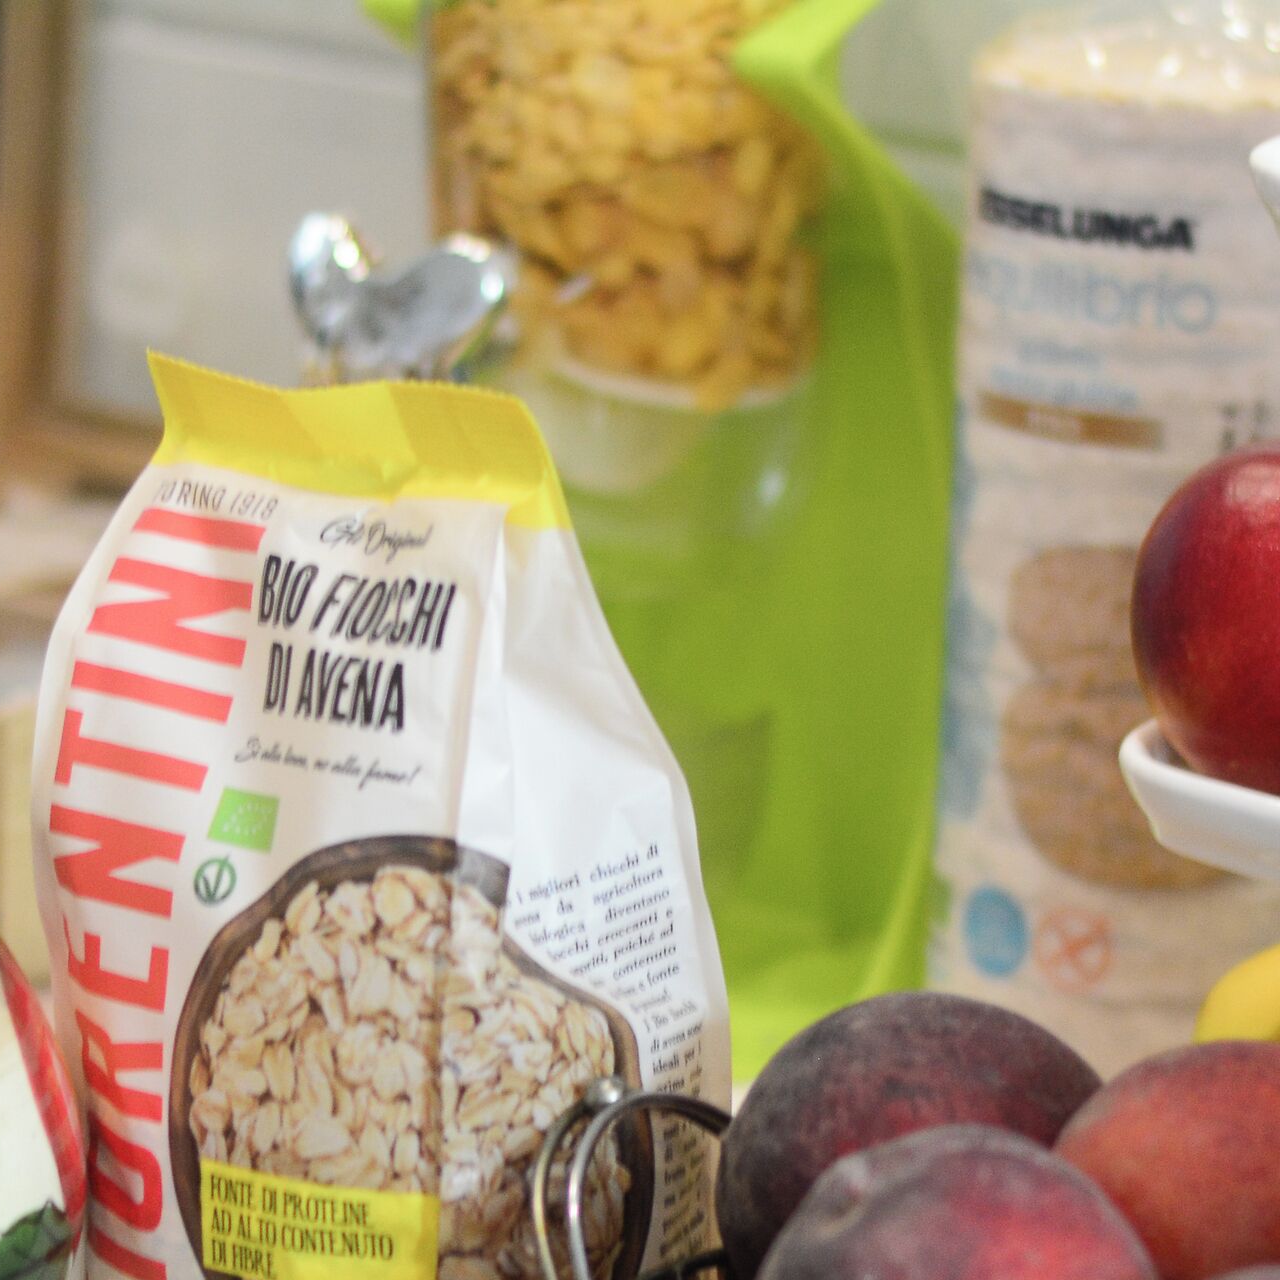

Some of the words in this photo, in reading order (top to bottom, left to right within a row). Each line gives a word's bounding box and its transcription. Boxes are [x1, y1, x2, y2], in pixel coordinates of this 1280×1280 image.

[230, 491, 279, 520] 1918
[258, 555, 319, 629] BIO
[309, 574, 456, 650] FIOCCHI
[263, 641, 293, 716] DI
[294, 648, 404, 731] AVENA
[529, 873, 580, 900] migliori
[590, 854, 639, 882] chicchi
[647, 842, 659, 860] di
[557, 898, 573, 915] da
[593, 866, 663, 904] agricoltura
[605, 888, 669, 922] diventano
[597, 912, 658, 947] croccanti
[660, 923, 674, 940] ad
[613, 944, 676, 980] contenuto
[646, 964, 680, 988] fonte
[651, 1038, 660, 1053] di
[652, 1053, 680, 1076] ideali
[211, 1174, 254, 1206] FONTE
[262, 1186, 278, 1216] DI
[283, 1191, 371, 1227] PROTEINE
[211, 1206, 232, 1237] AD
[237, 1215, 277, 1246] ALTO
[281, 1226, 395, 1261] CONTENUTO
[211, 1239, 227, 1266] DI
[232, 1244, 276, 1280] FIBRE
